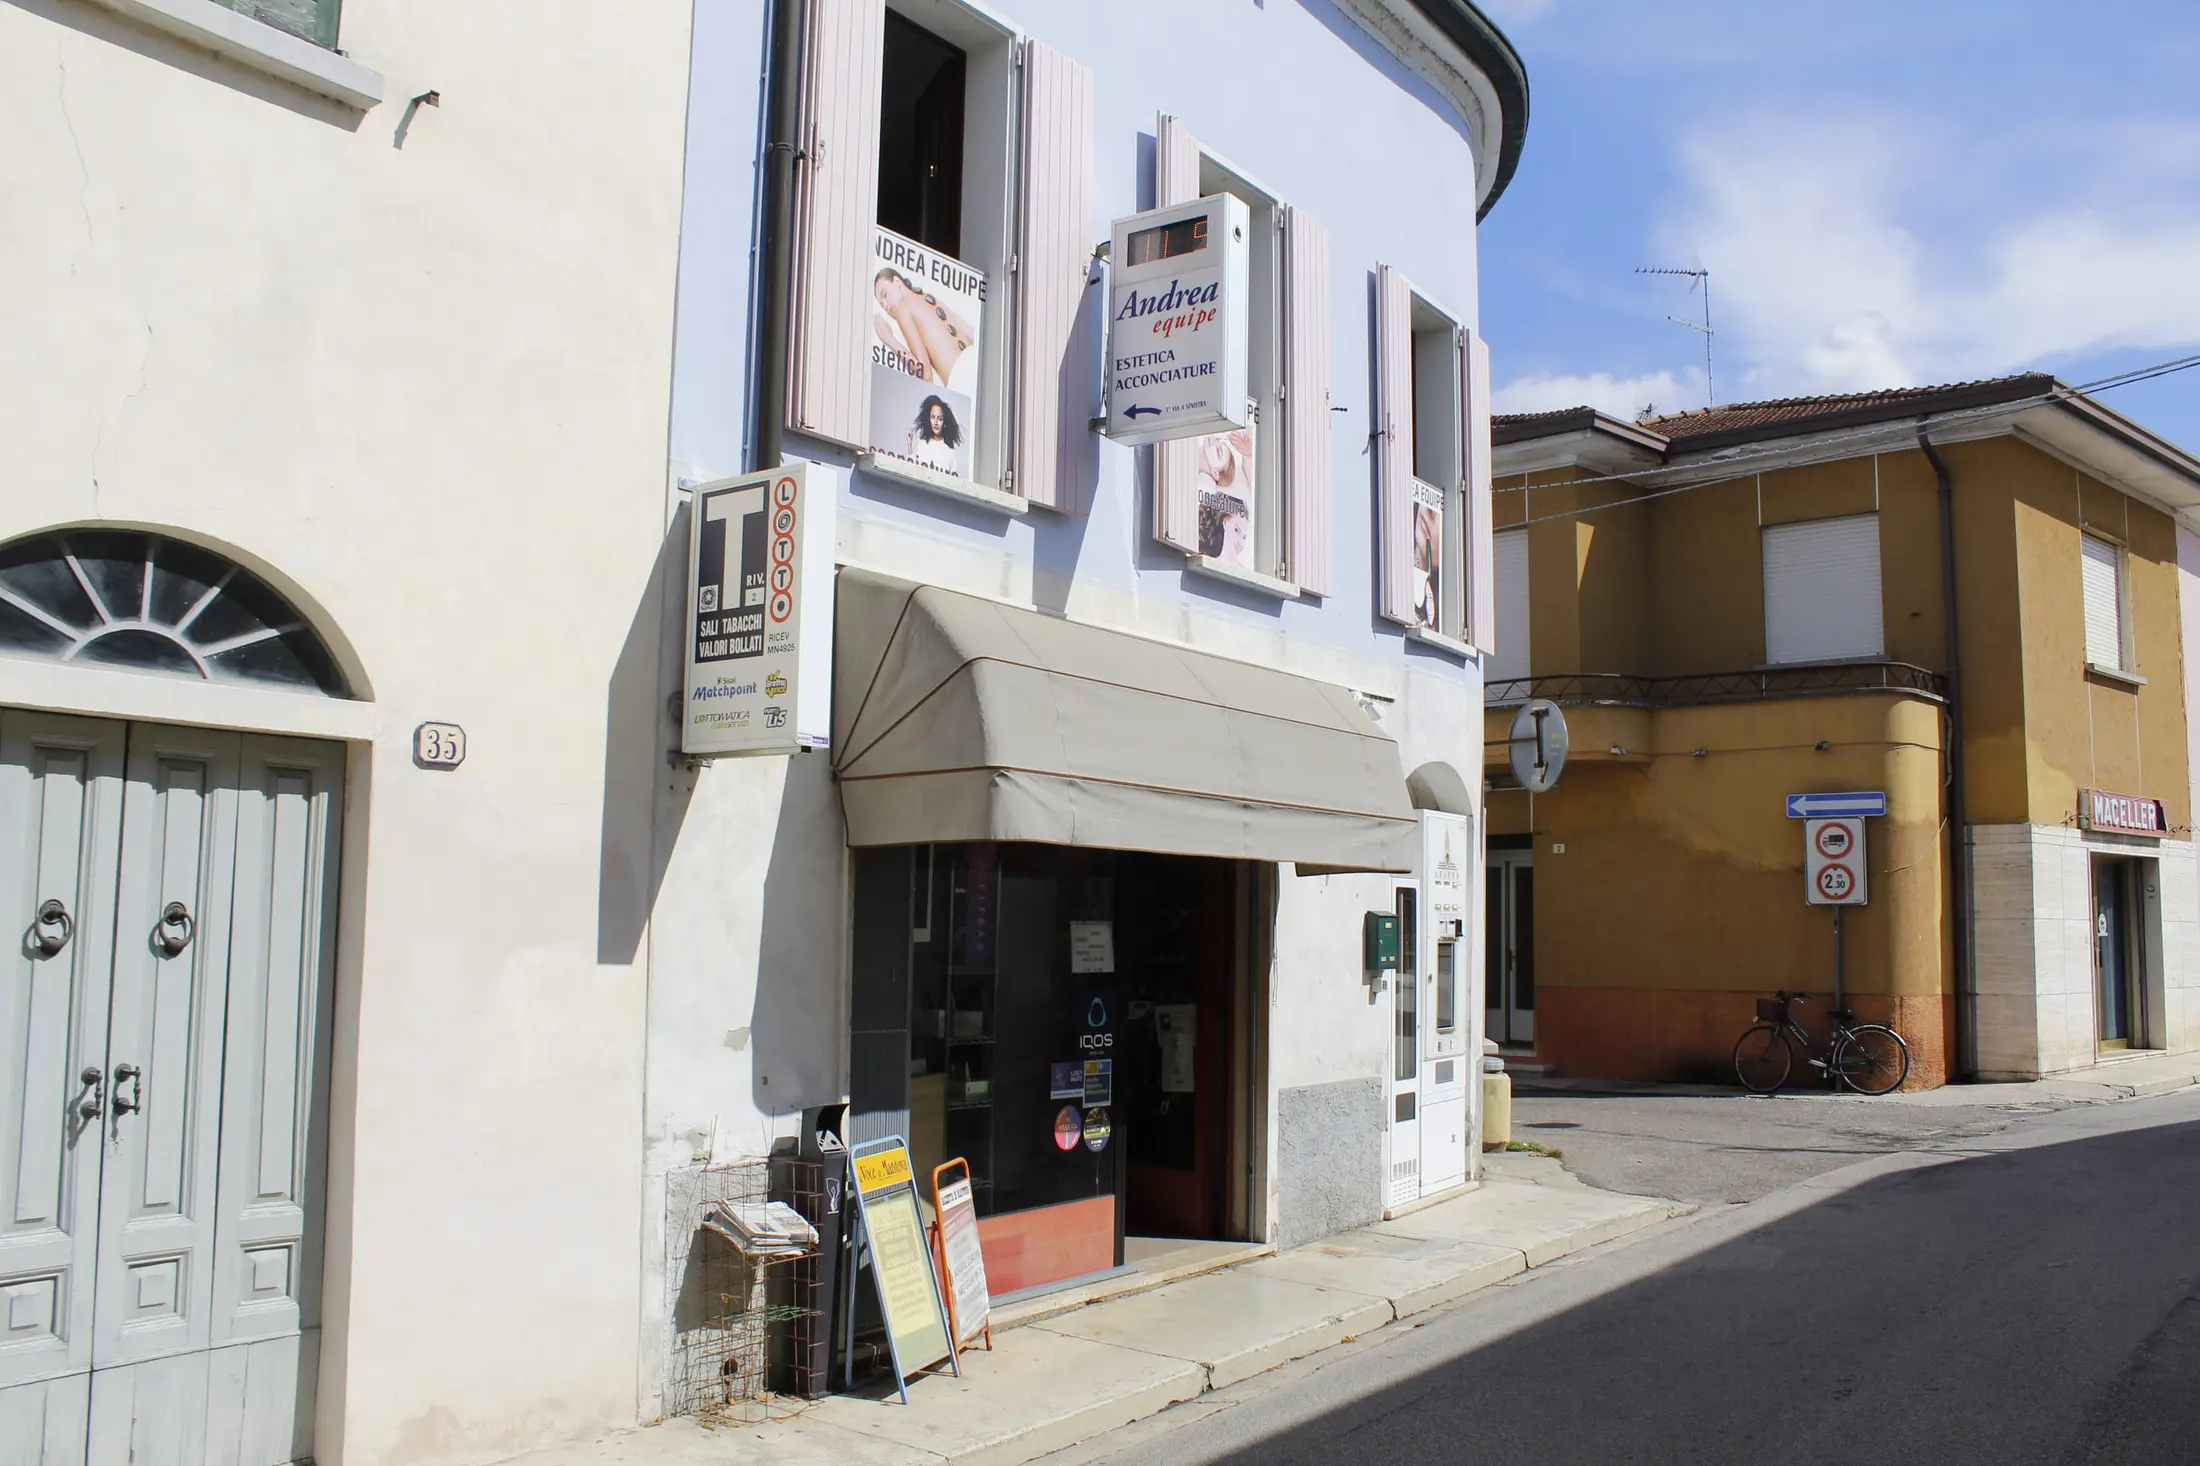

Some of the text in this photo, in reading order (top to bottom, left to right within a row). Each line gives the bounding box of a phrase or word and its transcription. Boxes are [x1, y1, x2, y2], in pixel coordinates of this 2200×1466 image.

[931, 259, 987, 302] EQUIPE
[1116, 279, 1219, 322] Andrea
[1152, 307, 1217, 338] equipe
[872, 345, 925, 380] stetica
[1116, 349, 1176, 372] ESTETICA
[1115, 361, 1217, 391] ACCONCIATURE
[705, 486, 764, 611] T
[769, 477, 798, 623] LOTTO
[746, 572, 765, 587] RIV.
[751, 592, 758, 602] 2
[700, 613, 763, 637] SALI TABACCHI
[768, 632, 790, 643] RICEV
[699, 634, 763, 658] VALORI BOLLATI
[692, 682, 758, 701] Matchpoint
[694, 711, 750, 724] LOTTOMATICA
[426, 729, 457, 760] 35
[2093, 796, 2157, 831] MACELLER
[1080, 1033, 1113, 1049] IQOS
